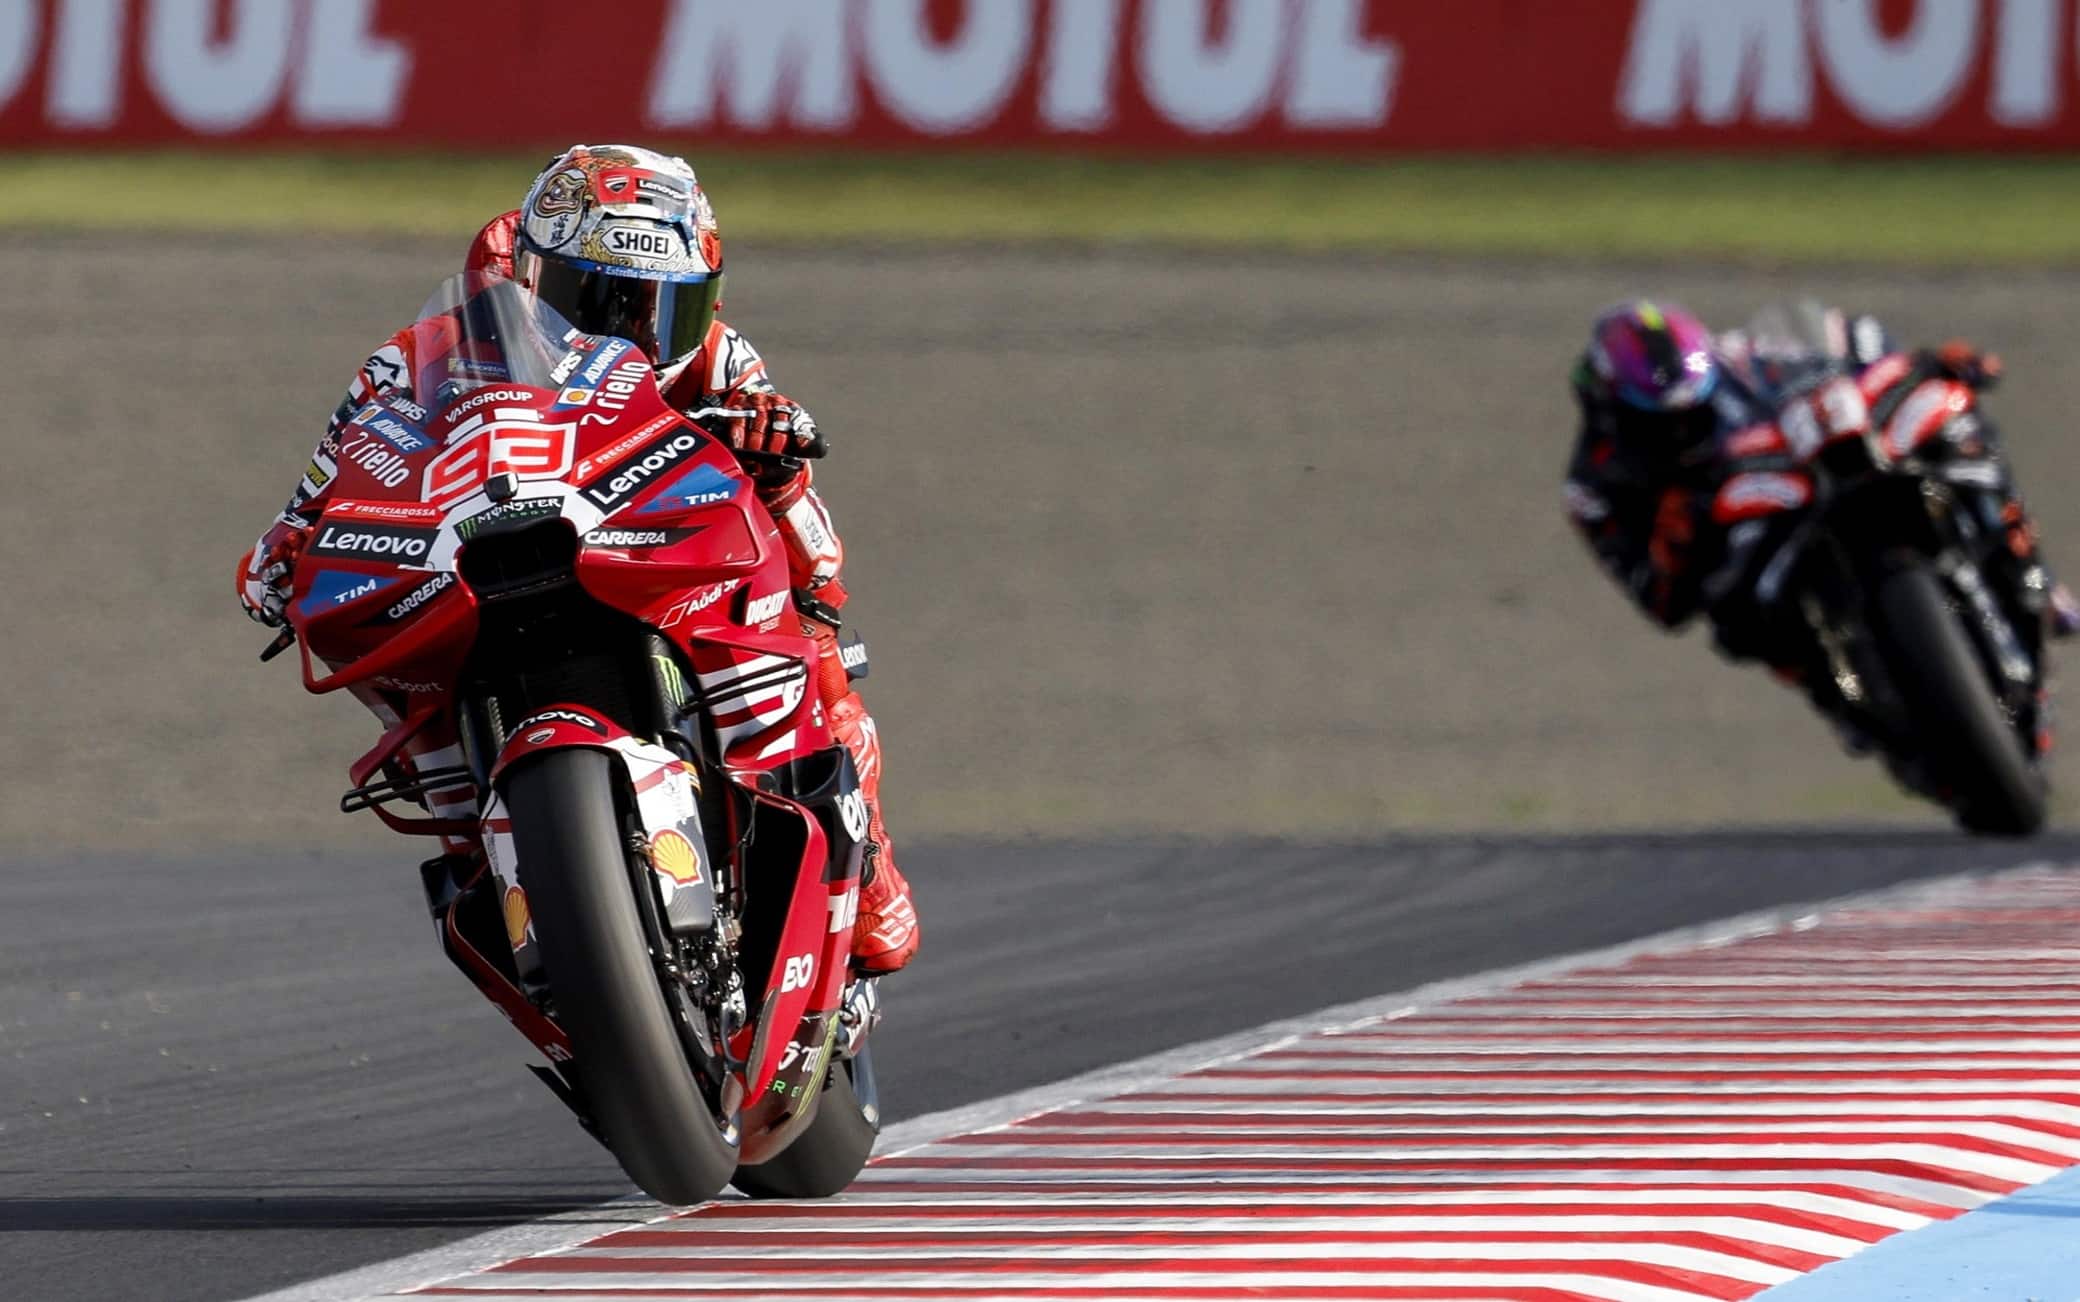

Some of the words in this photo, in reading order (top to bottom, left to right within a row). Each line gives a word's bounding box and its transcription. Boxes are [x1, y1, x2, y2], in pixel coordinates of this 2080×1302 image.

[0, 0, 409, 131] UL
[1615, 0, 2080, 129] MO
[639, 179, 688, 199] Lenovo
[612, 231, 669, 255] SHOEI
[582, 340, 628, 385] ADVANCE
[597, 361, 651, 410] riello
[445, 390, 534, 423] VARGROUP
[369, 418, 423, 452] ADVANCE
[595, 414, 677, 465] FRECCIAROSSA
[349, 442, 410, 488] riello
[589, 434, 696, 505] Lenovo
[354, 505, 436, 517] FRECCIAROSSA
[477, 498, 562, 524] MONSTER
[684, 490, 730, 506] TIM
[317, 527, 427, 556] Lenovo
[584, 530, 667, 545] CARRERA
[335, 578, 377, 604] TIM
[388, 571, 454, 619] CARRERA
[686, 583, 723, 616] Audi
[838, 643, 868, 669] Leno
[508, 711, 596, 737] novo
